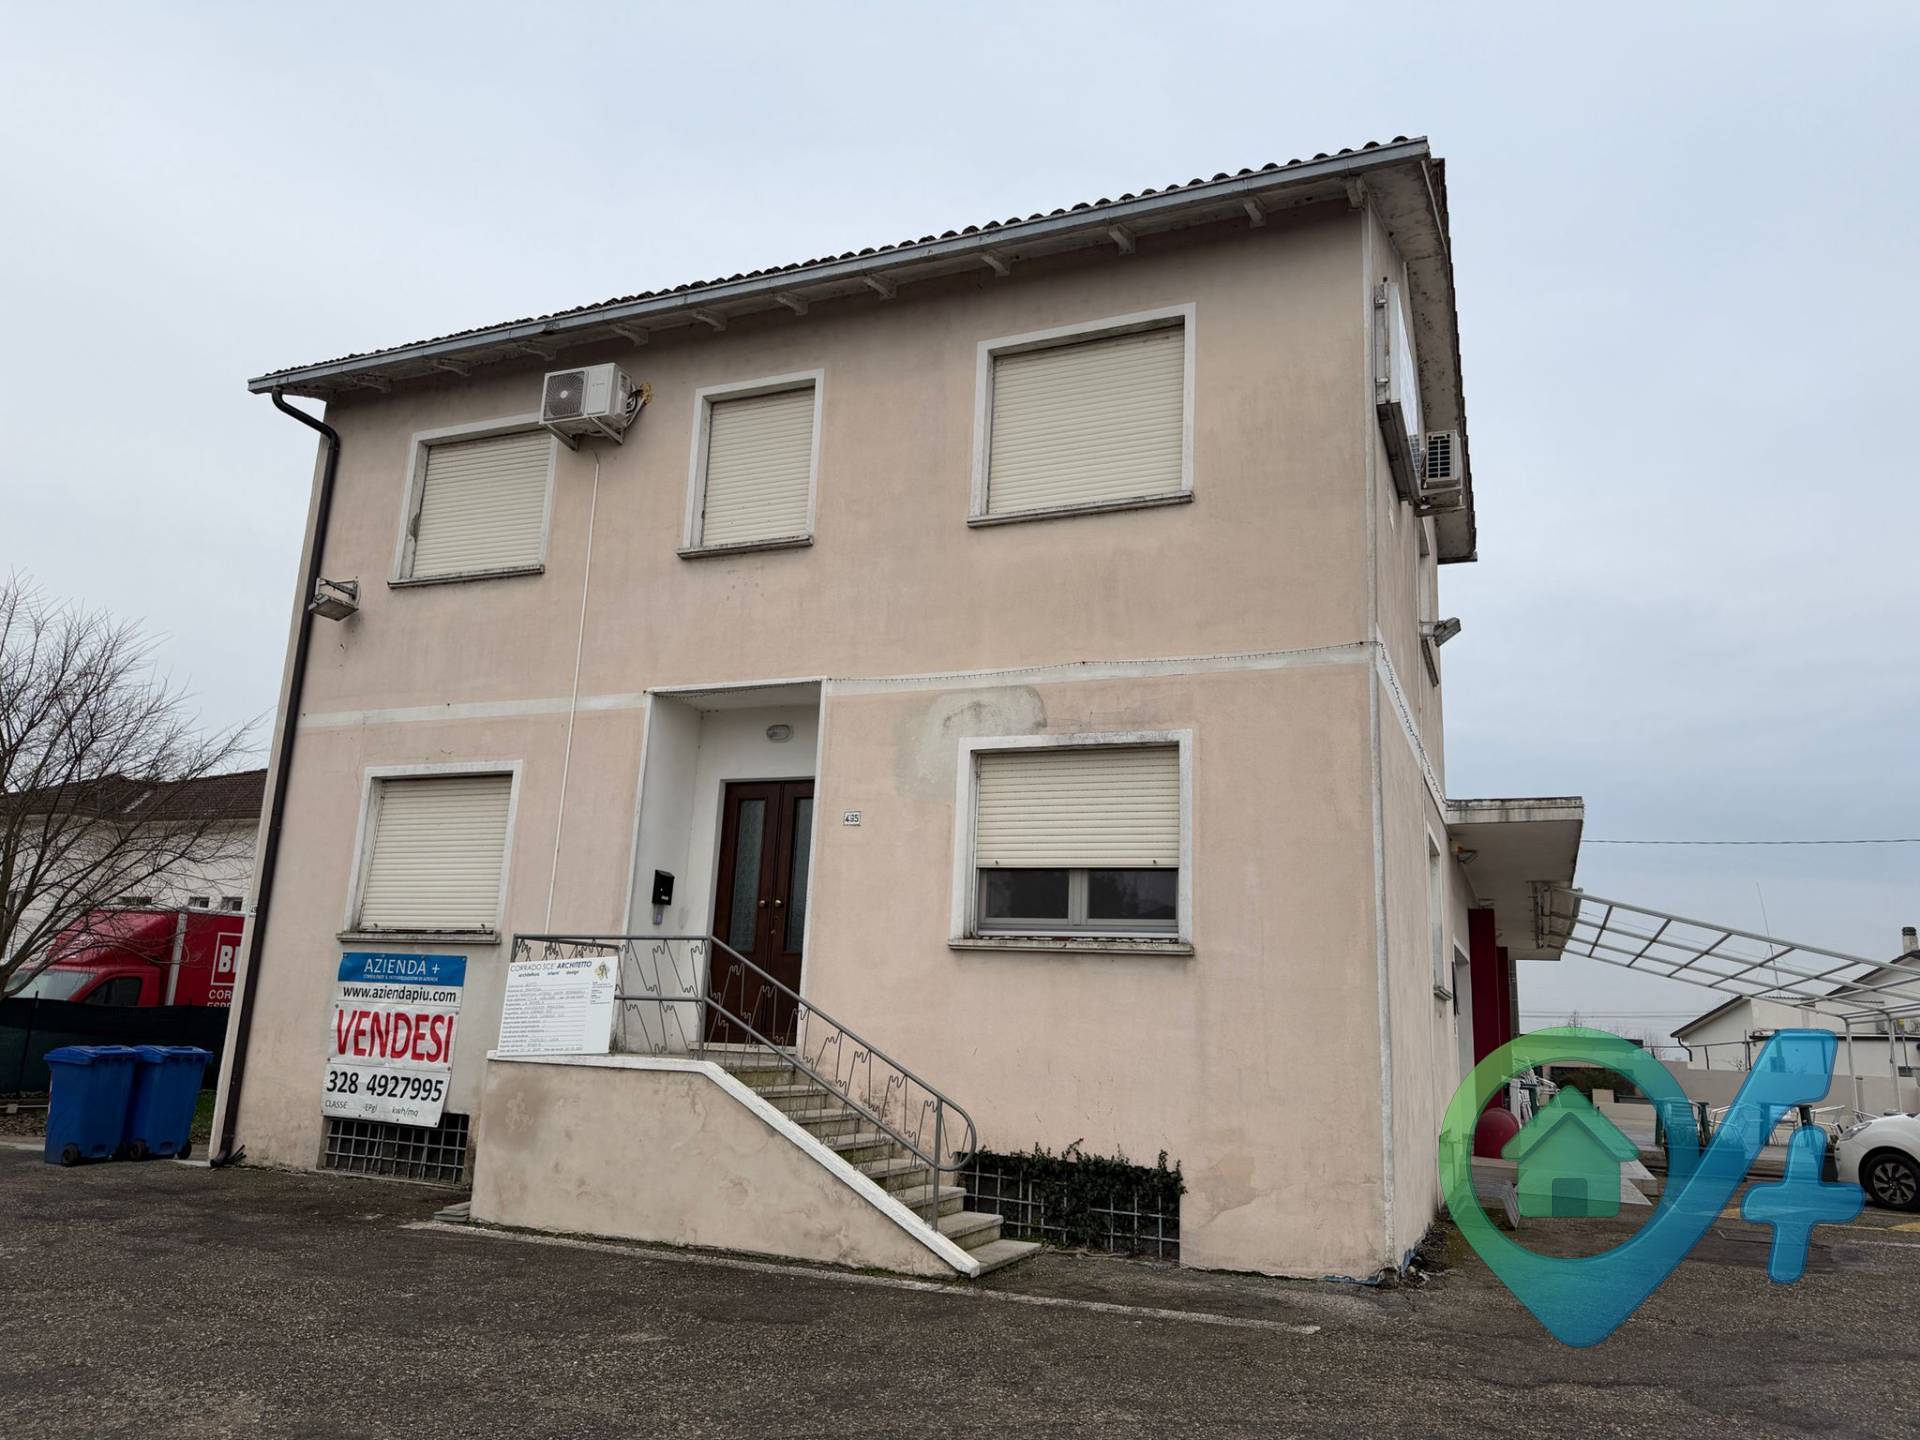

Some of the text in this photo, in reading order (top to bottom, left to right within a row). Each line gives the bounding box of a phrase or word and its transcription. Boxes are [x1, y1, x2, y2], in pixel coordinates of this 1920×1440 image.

[364, 958, 427, 975] AZIENDA
[511, 963, 541, 972] CORRADO
[557, 961, 592, 969] ARCHITETTO
[343, 986, 457, 1003] www.aziendapiu.com
[337, 1009, 454, 1063] VENDESI
[326, 1070, 444, 1102] 328 4927995
[325, 1100, 348, 1110] CLASSE
